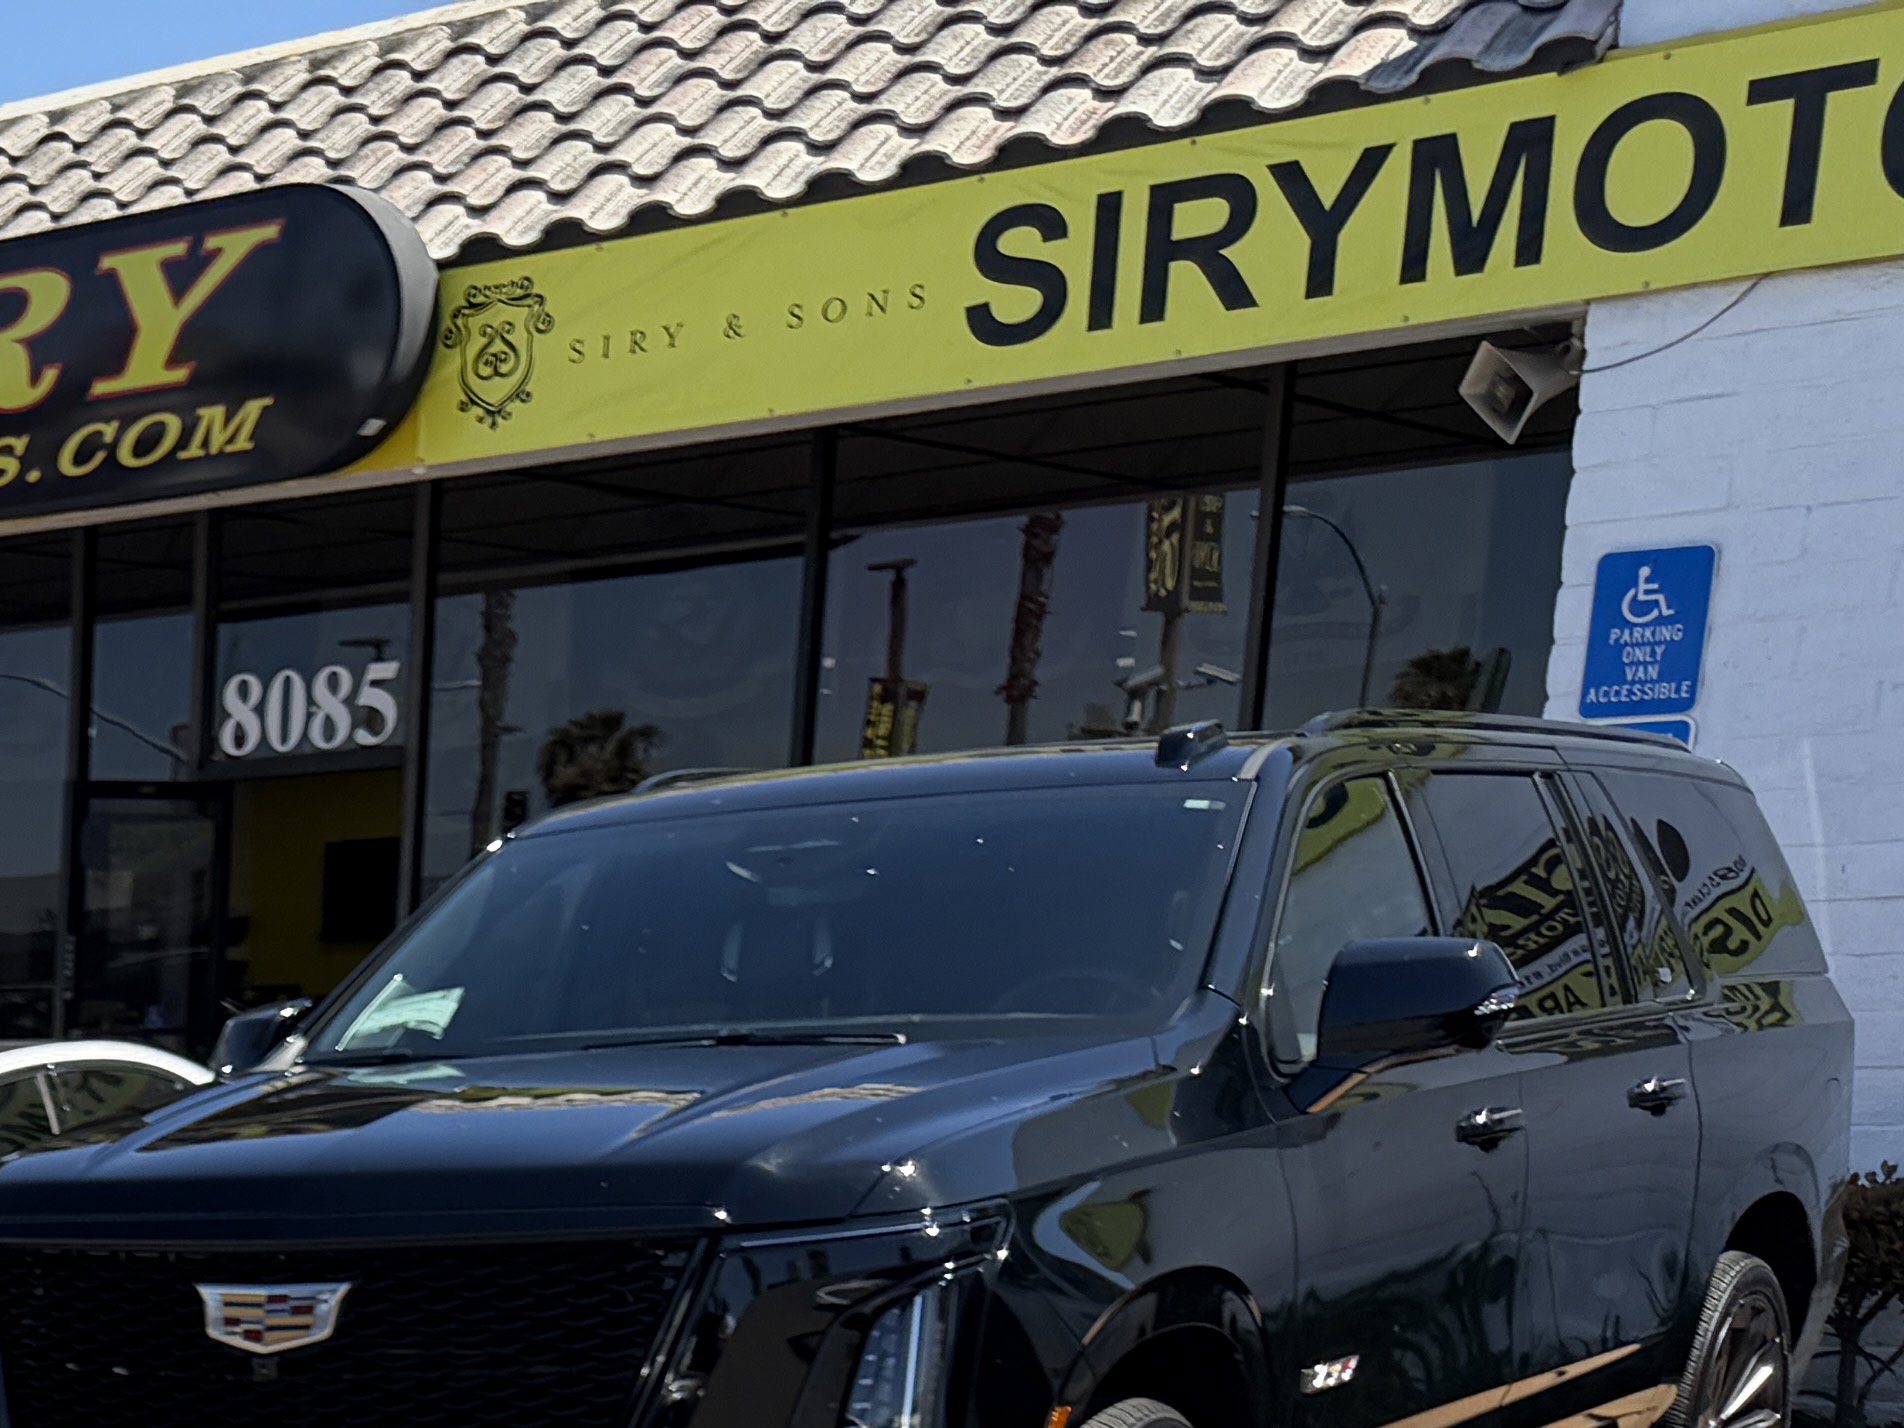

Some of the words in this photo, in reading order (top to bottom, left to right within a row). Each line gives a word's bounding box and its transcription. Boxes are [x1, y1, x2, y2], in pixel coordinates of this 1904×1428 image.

[964, 58, 1904, 347] SIRYMOT
[568, 322, 684, 364] SIRY
[723, 313, 746, 340] &
[786, 283, 927, 330] SONS
[1609, 624, 1684, 645] PARKING
[1621, 644, 1666, 664] ONLY
[1624, 663, 1660, 681] VAN
[1585, 681, 1692, 704] ACCESSIBLE
[219, 660, 401, 757] 8085
